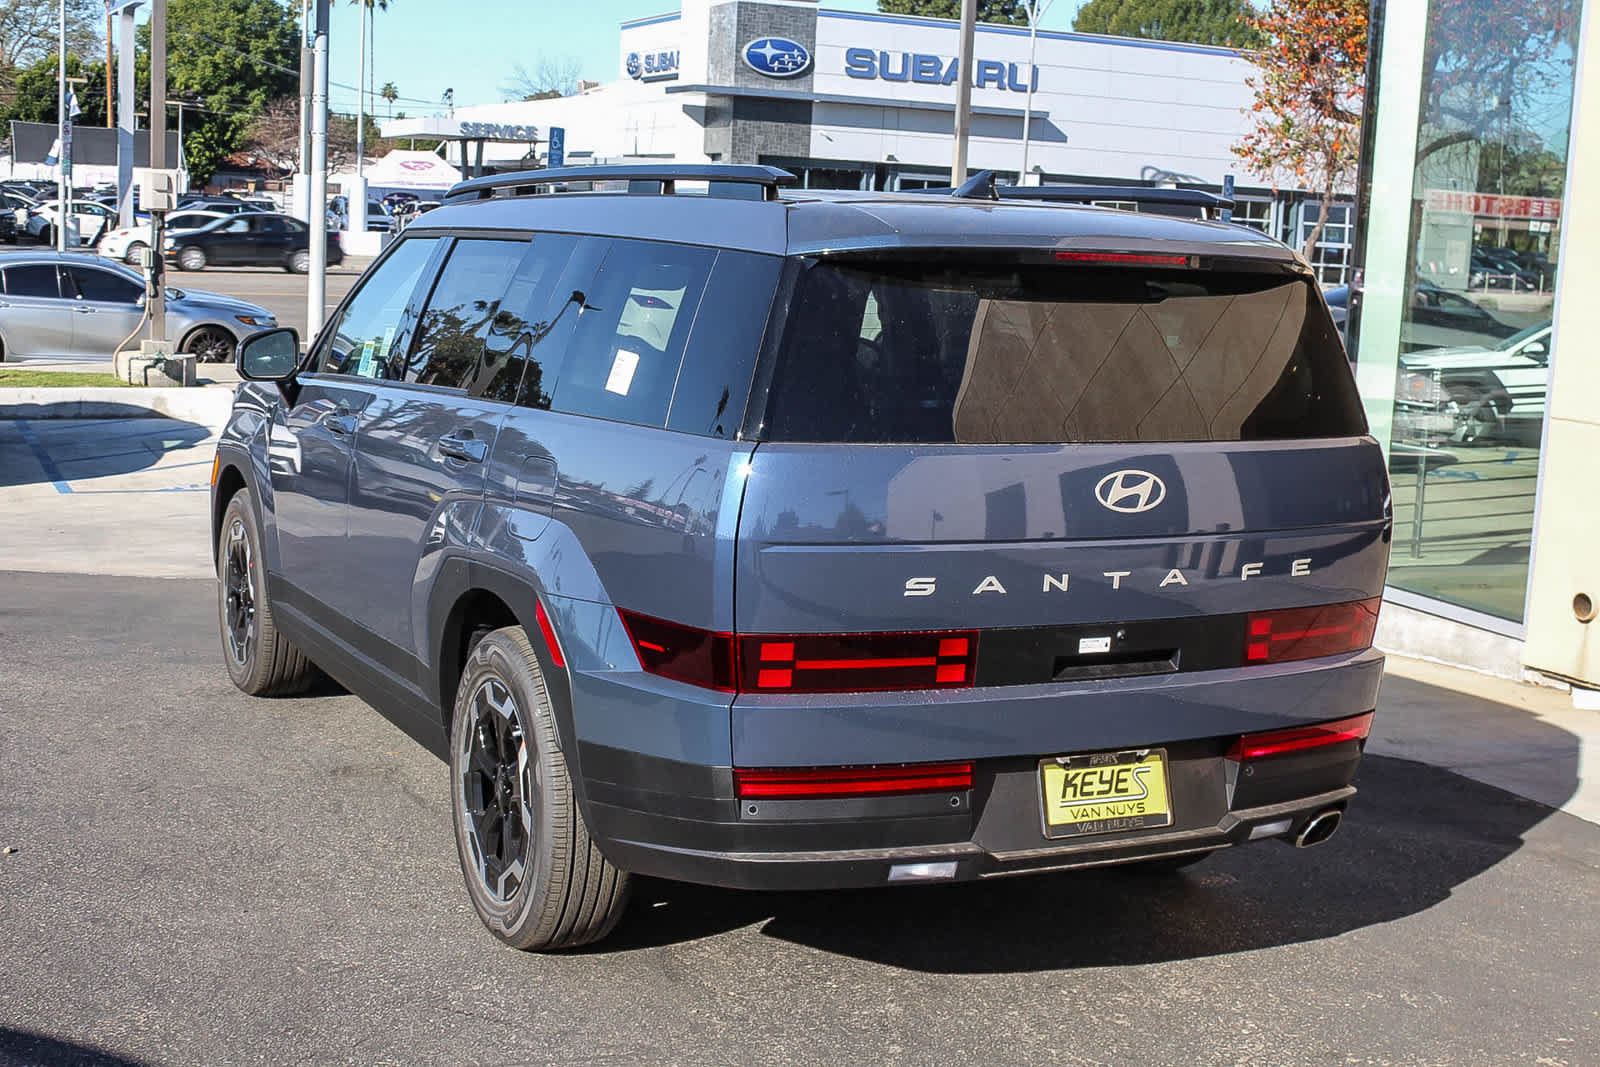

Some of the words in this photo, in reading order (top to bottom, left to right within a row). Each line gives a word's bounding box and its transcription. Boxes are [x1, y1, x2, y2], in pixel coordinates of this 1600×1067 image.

[460, 121, 538, 140] SERVICE
[903, 568, 1189, 597] SANTA
[1240, 557, 1313, 581] FE
[1061, 765, 1152, 799] KEYES
[1070, 806, 1101, 819] VAN
[1106, 802, 1145, 816] NUYS
